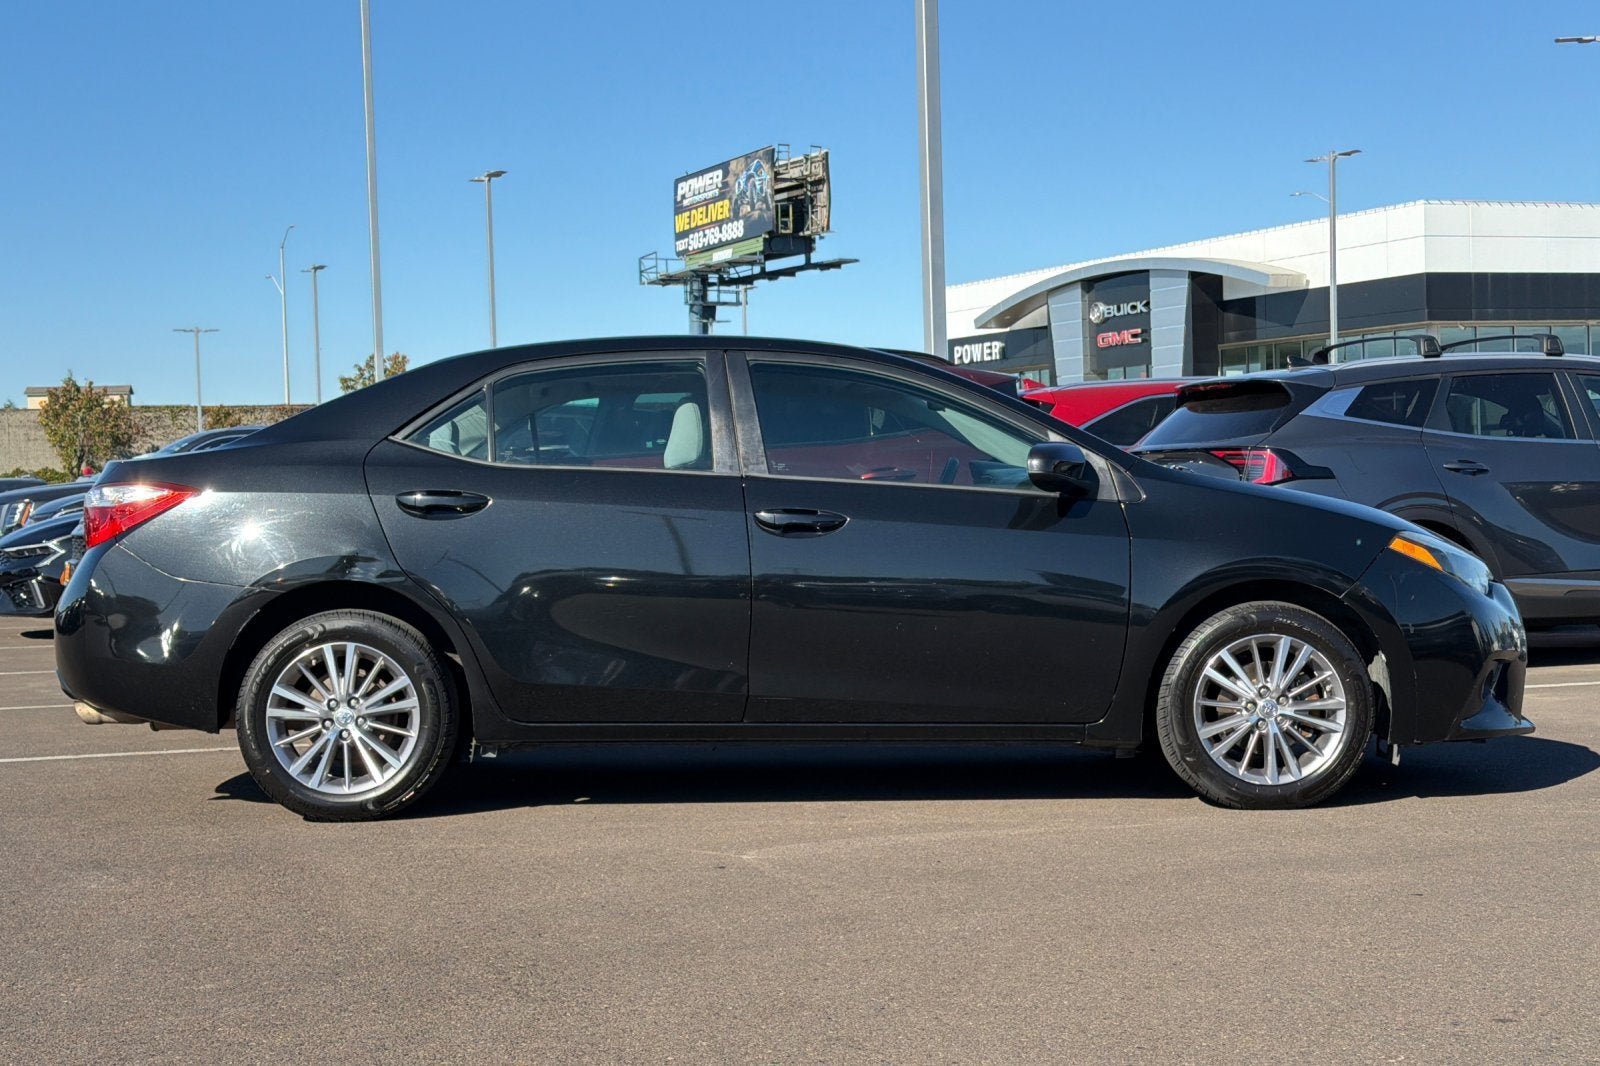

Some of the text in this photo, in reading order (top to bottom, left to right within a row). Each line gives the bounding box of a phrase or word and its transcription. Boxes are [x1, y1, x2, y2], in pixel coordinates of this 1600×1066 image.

[677, 169, 723, 201] POWER
[675, 200, 730, 233] WE DELIVER
[676, 219, 744, 252] TEXT 503-769-8888
[1104, 300, 1149, 317] BUICK
[953, 340, 1001, 365] POWER
[1097, 329, 1142, 348] GMC
